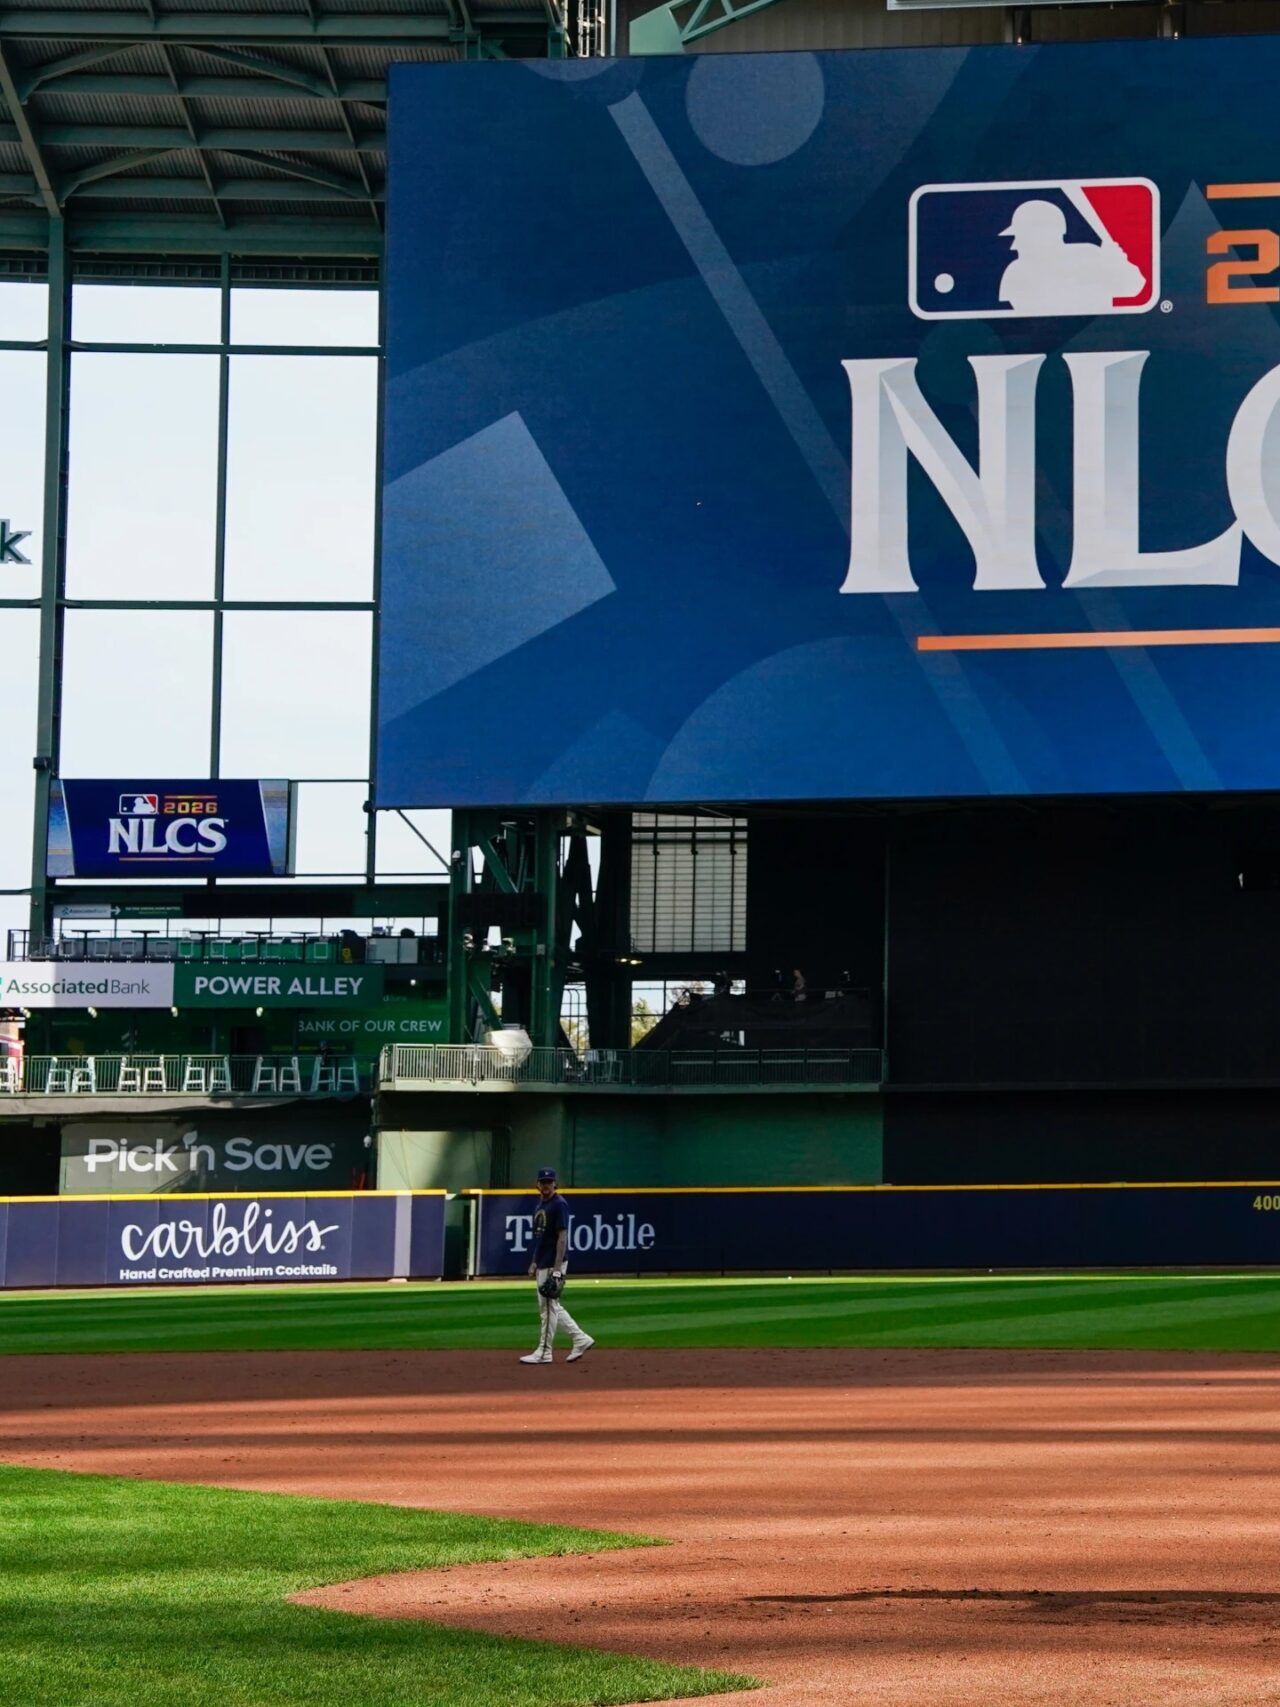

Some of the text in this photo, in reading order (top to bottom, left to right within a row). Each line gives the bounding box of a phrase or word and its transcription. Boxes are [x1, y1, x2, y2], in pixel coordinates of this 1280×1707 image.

[163, 801, 218, 814] 2026
[107, 817, 228, 854] NLCS
[194, 976, 364, 996] POWER ALLEY
[339, 1019, 361, 1033] OF
[364, 1019, 396, 1033] OUR
[400, 1019, 443, 1033] CREW
[83, 1137, 179, 1173] Pick
[223, 1137, 334, 1172] Save
[121, 1201, 340, 1261] carbliss
[119, 1264, 338, 1280] Hand Crafted Premium Cocktails
